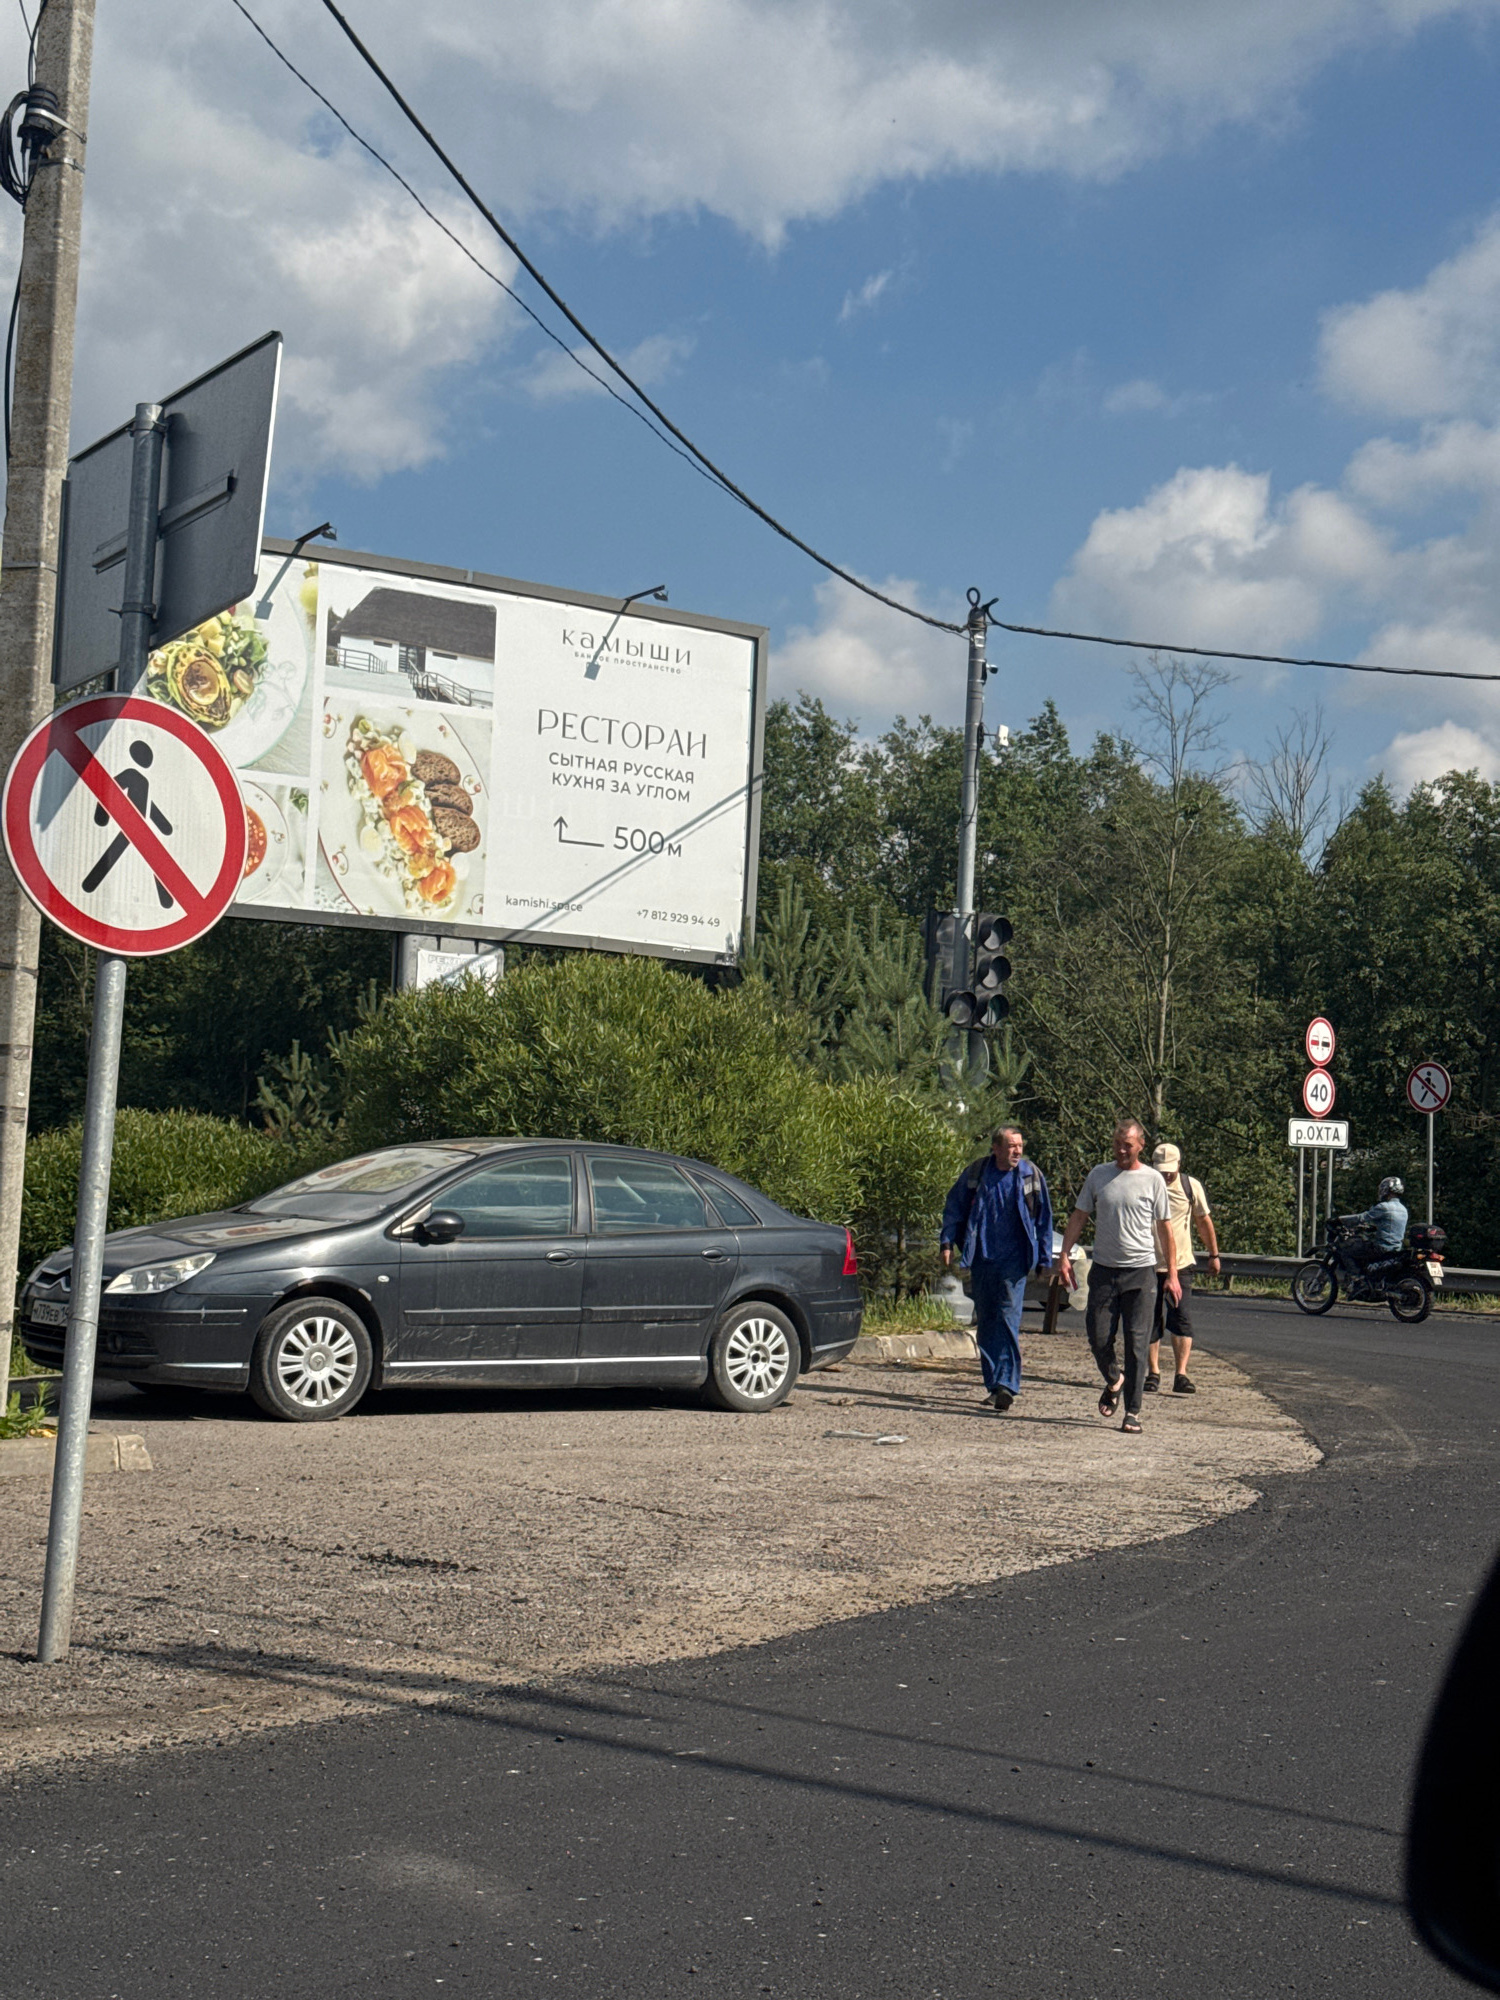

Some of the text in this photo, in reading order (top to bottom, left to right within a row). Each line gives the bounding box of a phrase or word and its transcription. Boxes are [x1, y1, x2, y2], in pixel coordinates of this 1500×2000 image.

[574, 651, 682, 674] БАНОЕ ПРОСТРАНСТВО
[538, 709, 707, 759] РЕСТОРАН
[549, 752, 695, 784] СЫТНАЯ РУССКАЯ
[552, 772, 691, 803] КУХНЯ ЗА УГЛОМ
[505, 895, 583, 912] kamishi.space
[636, 909, 720, 928] +7 812 929 94 49
[1310, 1083, 1328, 1102] 40
[1296, 1126, 1341, 1144] р.ОХТА
